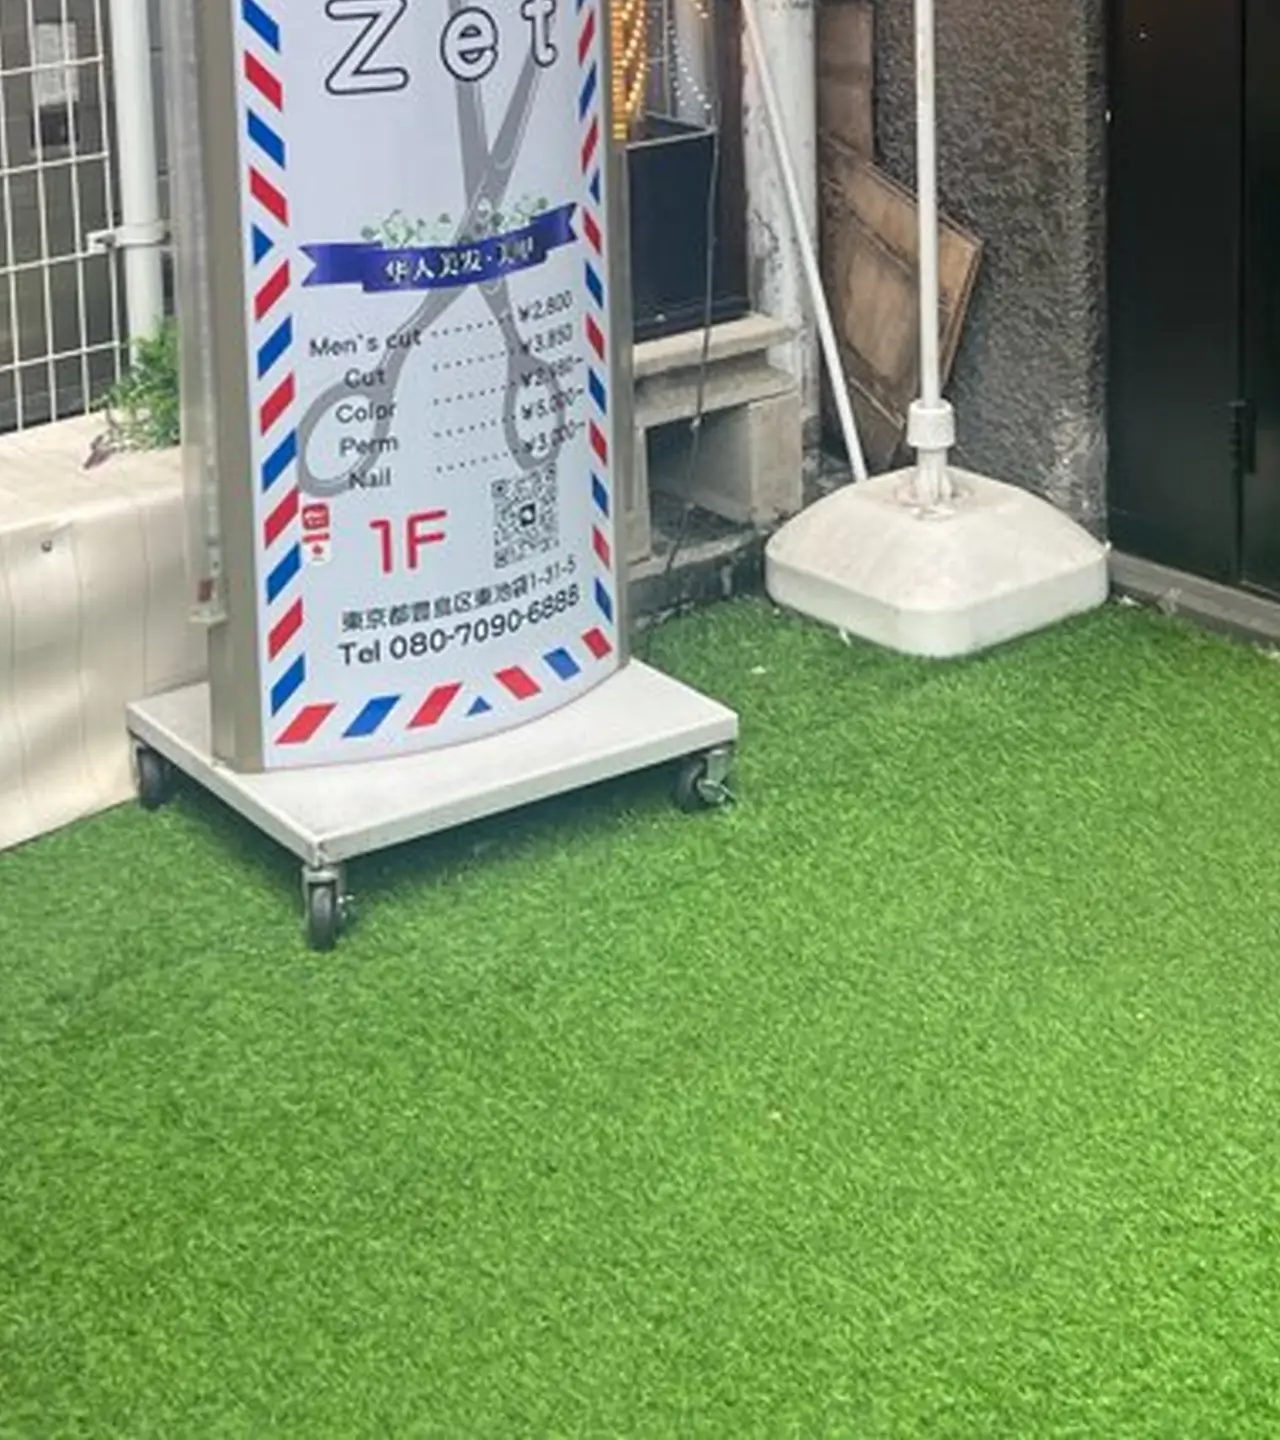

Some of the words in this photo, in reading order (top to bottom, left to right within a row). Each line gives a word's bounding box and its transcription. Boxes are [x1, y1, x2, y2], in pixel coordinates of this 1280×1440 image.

[386, 329, 422, 350] cut
[344, 368, 385, 389] Cut
[335, 402, 397, 424] Color
[339, 436, 399, 458] Perm
[348, 468, 391, 490] Nail
[369, 509, 448, 574] 1F
[338, 639, 381, 666] Tel
